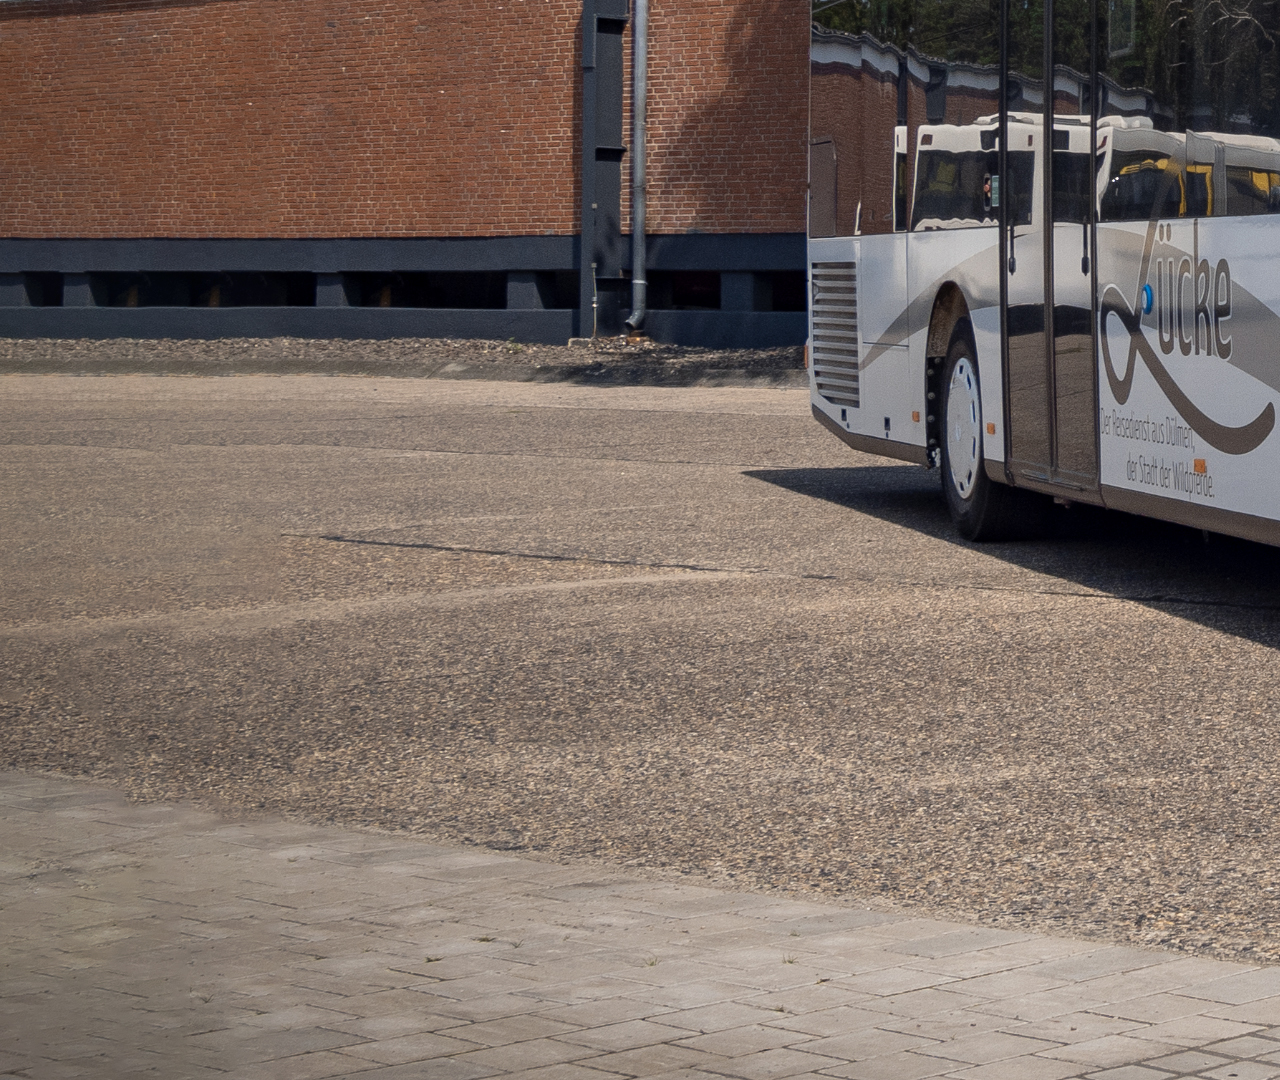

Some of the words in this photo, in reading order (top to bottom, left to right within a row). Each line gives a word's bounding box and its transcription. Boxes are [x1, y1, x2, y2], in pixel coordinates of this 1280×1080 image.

[1101, 158, 1276, 455] Lücke
[1101, 407, 1112, 435] Der
[1113, 409, 1151, 442] Reisedienst
[1152, 422, 1165, 444] aus
[1165, 416, 1195, 453] Dülmen,
[1127, 452, 1137, 481] der
[1139, 455, 1158, 486] Stadt
[1160, 458, 1171, 488] der
